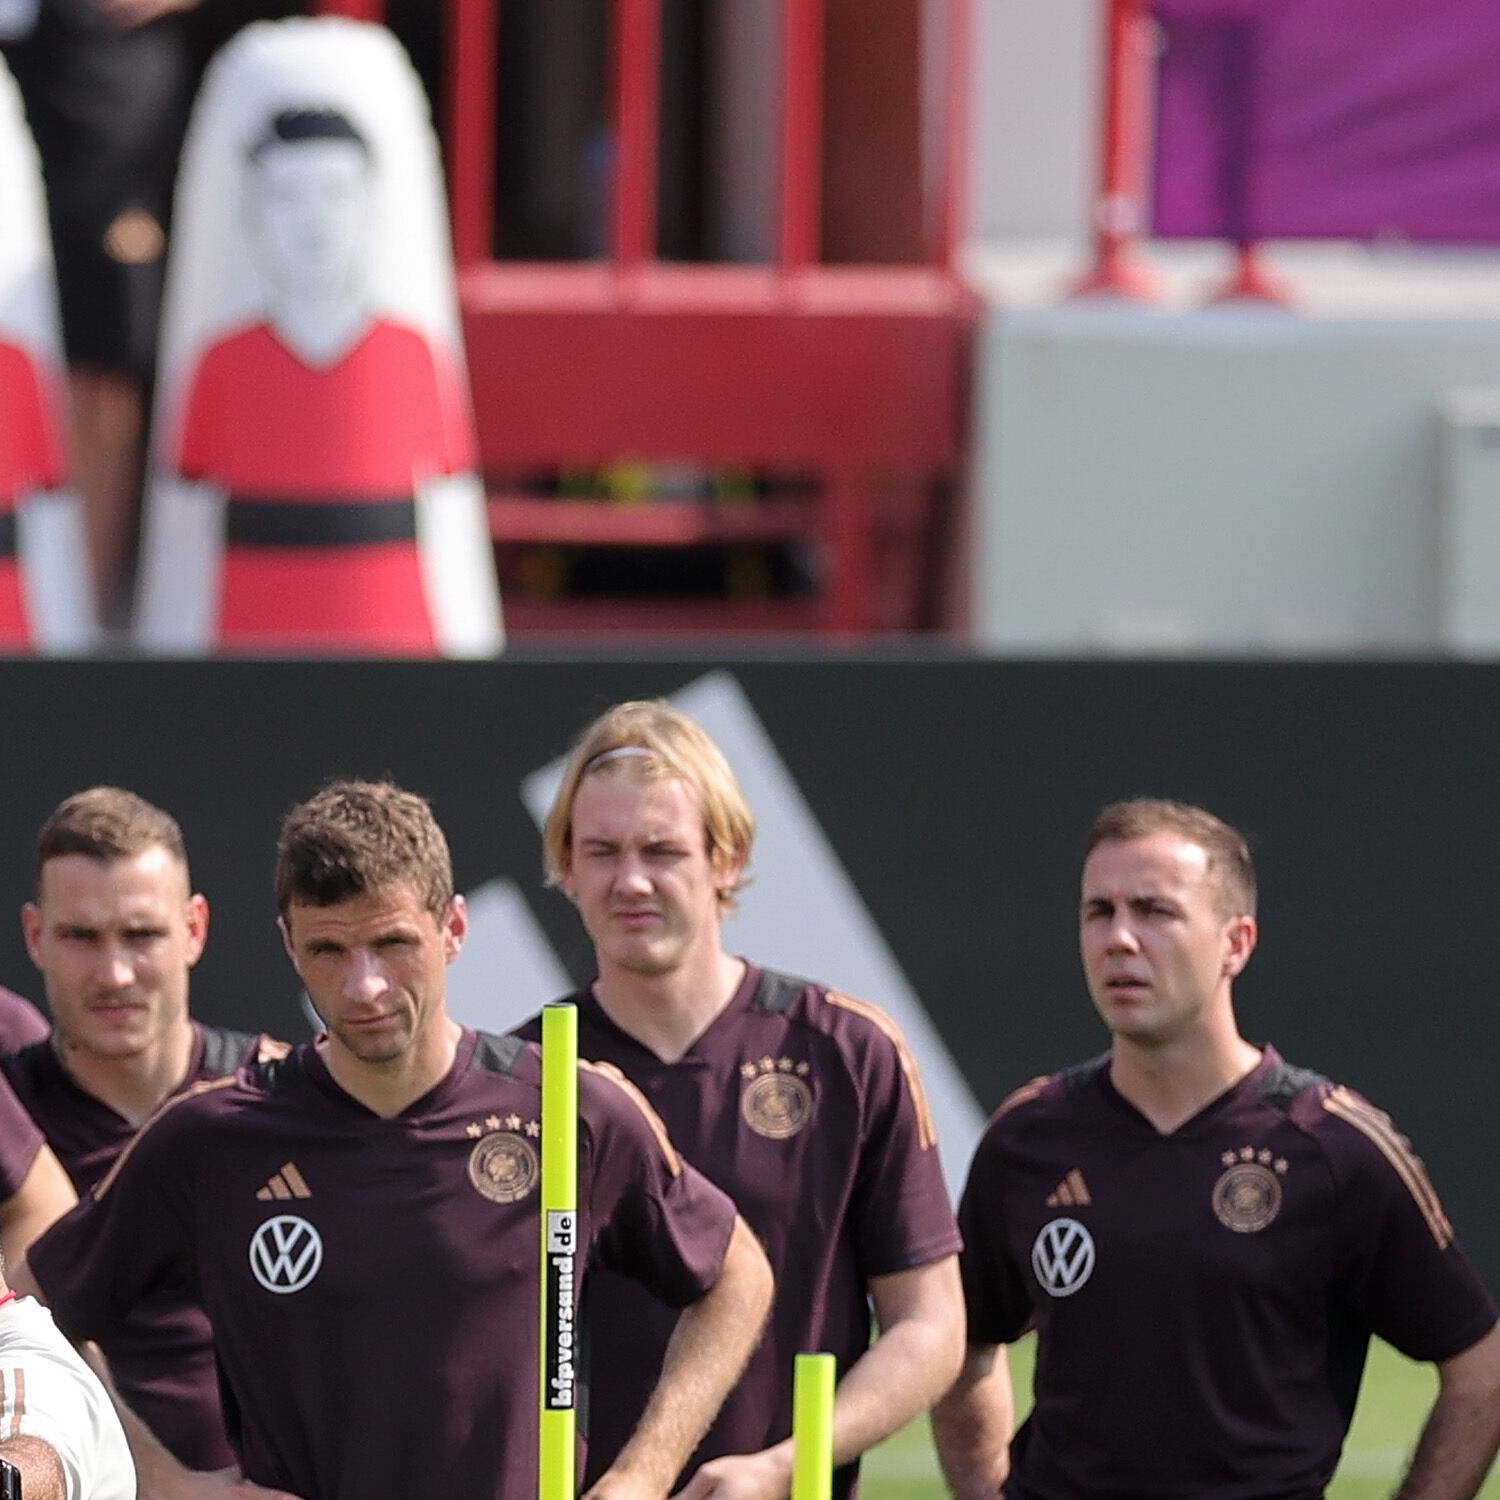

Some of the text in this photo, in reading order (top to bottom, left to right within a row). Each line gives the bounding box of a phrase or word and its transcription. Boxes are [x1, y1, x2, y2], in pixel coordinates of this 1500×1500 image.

[250, 1216, 323, 1293] VW
[1033, 1219, 1095, 1297] VW
[551, 1216, 575, 1407] bfpversand.de
